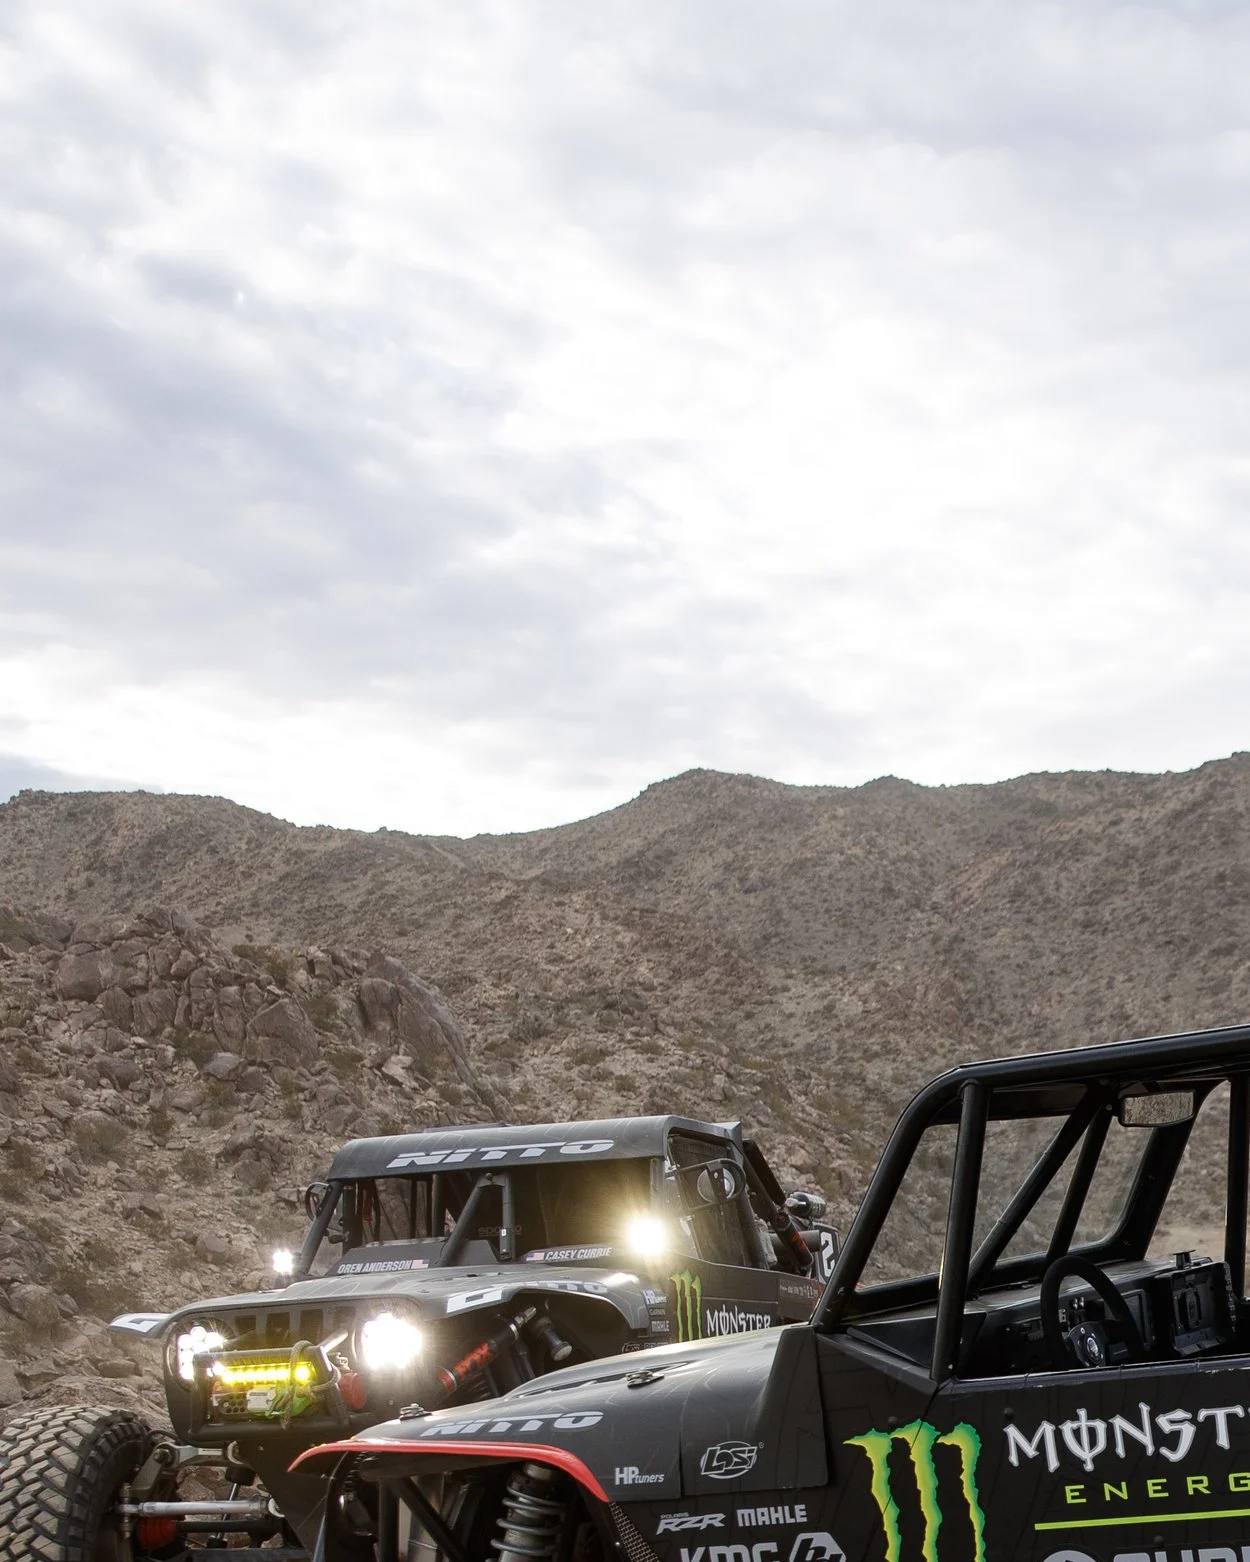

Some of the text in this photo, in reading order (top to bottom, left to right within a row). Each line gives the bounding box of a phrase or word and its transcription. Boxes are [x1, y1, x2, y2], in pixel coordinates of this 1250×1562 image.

[386, 1139, 614, 1168] NITTO
[545, 1247, 612, 1260] CASEY CURRIE
[337, 1260, 412, 1274] OREN ANDERSON
[706, 1303, 771, 1338] MONSTER
[420, 1411, 604, 1437] NITTO
[656, 1513, 726, 1535] RZR
[736, 1504, 808, 1527] MAHLE
